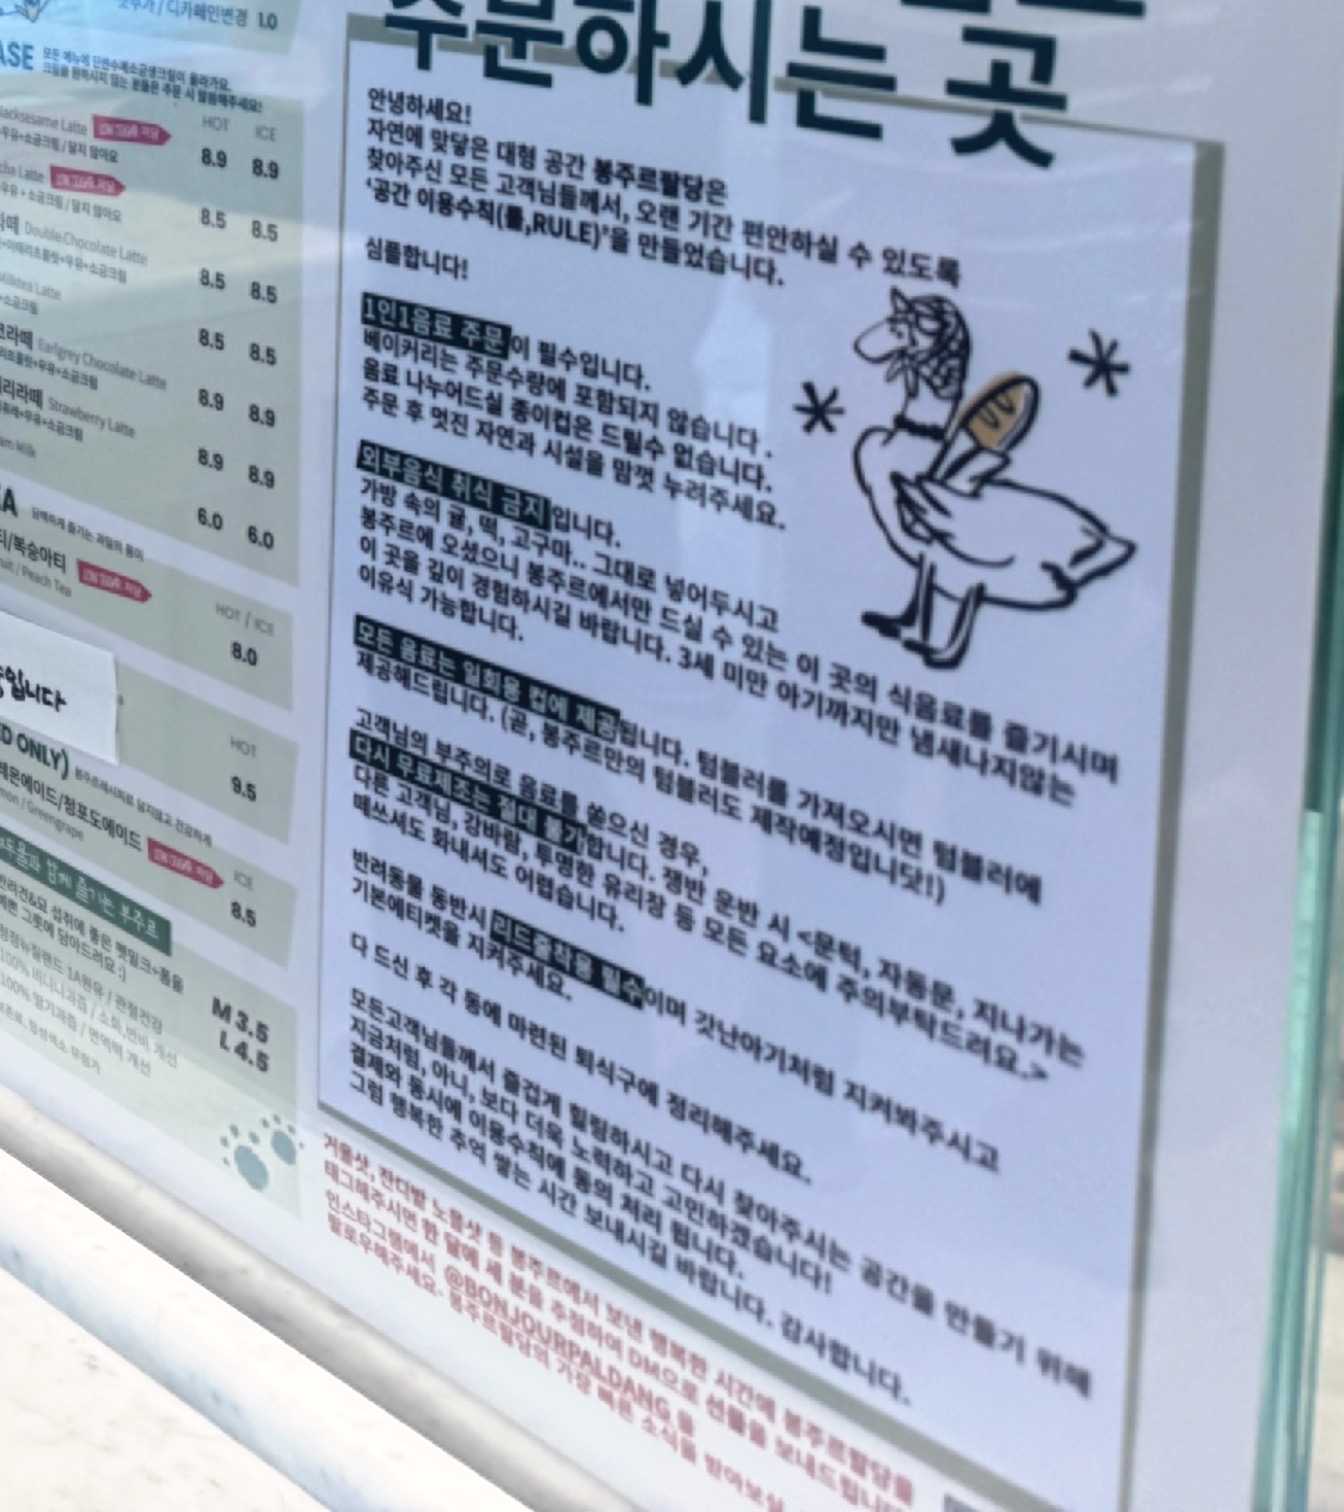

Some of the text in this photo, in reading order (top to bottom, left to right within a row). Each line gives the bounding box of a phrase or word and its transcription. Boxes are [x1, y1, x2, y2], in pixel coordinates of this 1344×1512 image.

[367, 88, 472, 125] 안녕하세요!
[945, 25, 1067, 170] 곳
[63, 117, 88, 136] Latte
[201, 115, 277, 143] HOT ICE
[17, 163, 44, 184] Latte
[201, 146, 280, 180] 8.9 8.9
[366, 118, 729, 208] 자연에 맞닿은 대형 공간 봉주르팔당은
[200, 207, 279, 243] 8.5 8.5
[366, 147, 962, 289] 찾아주신 모든 고객님들께서, 오랜 기간 편안하실 있도록
[365, 237, 470, 281] 심플합니다!
[637, 234, 785, 289] 만들었습니다.
[199, 267, 278, 306] 8.5 8.5
[37, 337, 81, 367] Earlgrey
[82, 351, 137, 382] Chocolate
[198, 327, 277, 367] 8.5 8.5
[363, 295, 652, 392] 1인1음료 필수입니다.
[362, 328, 660, 429] 베이커리는 주문수량에 포함되지
[47, 396, 106, 432] Strawberry
[197, 388, 276, 428] 8.9 8.9
[362, 357, 774, 494] 음료 나누어드실 종이컵은 드릴수 없습니다.
[197, 447, 275, 490] 8.9 8.9
[362, 386, 787, 531] 주문 자연과 시설을 누려주세요.
[197, 506, 275, 551] 6.0 6.0
[357, 563, 525, 643] 이유식 가능합니다.
[592, 550, 779, 634] 그대로 넣어두시고
[230, 640, 258, 667] 8.0
[359, 506, 1119, 787] 봉주르에 오셨으니 봉주르에서만 있는 식음료를 즐기시며
[470, 572, 902, 748] 경험하시길 바랍니다. 아기까지만
[355, 706, 430, 756] 고객님의
[15, 732, 70, 781] ONLY)
[797, 787, 924, 859] 가져오시면
[514, 861, 625, 934] 어렵습니다.
[235, 1009, 270, 1044] 3.5
